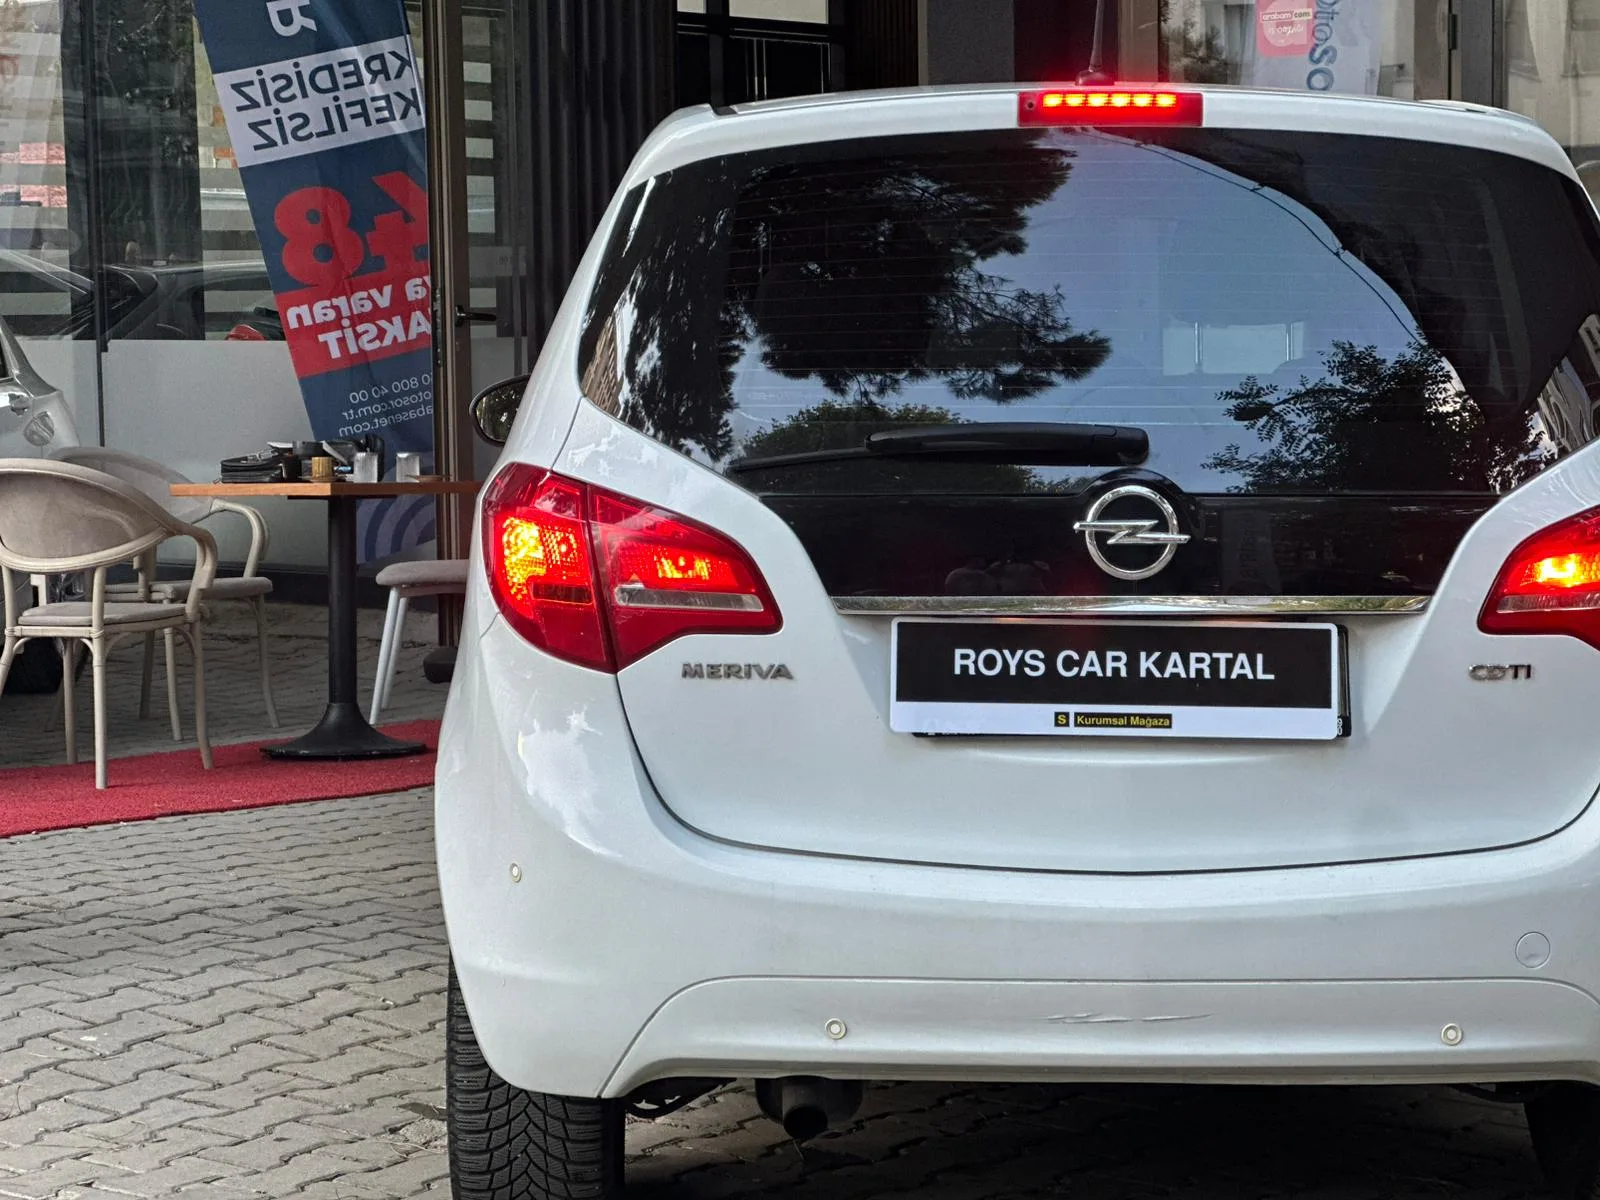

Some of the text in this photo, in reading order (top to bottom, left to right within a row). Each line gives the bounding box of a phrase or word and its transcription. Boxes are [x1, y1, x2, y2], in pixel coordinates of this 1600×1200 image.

[681, 662, 794, 680] MERIVA
[953, 648, 1276, 680] ROYS CAR KARTAL
[1076, 715, 1128, 726] Kurumsal
[1130, 715, 1171, 728] Mağaza
